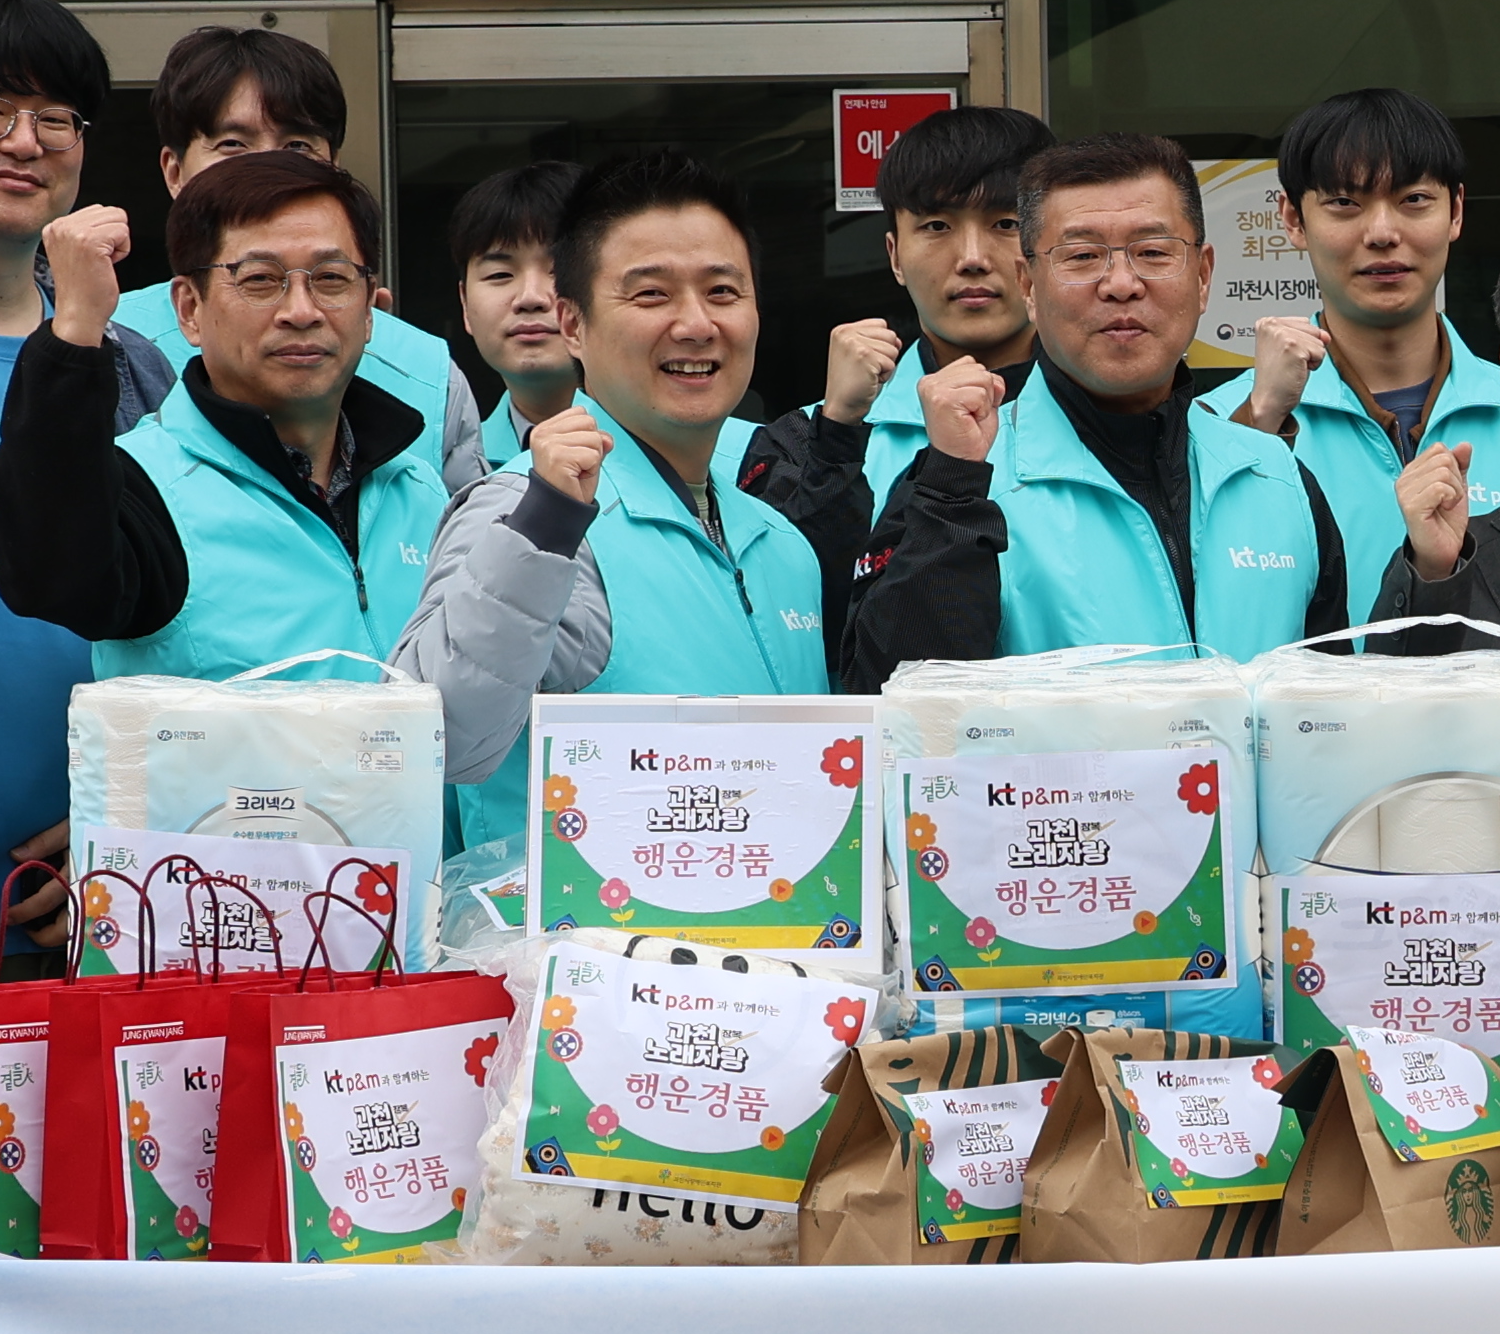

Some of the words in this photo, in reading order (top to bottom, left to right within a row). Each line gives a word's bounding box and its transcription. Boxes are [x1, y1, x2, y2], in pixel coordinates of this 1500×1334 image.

[845, 99, 868, 109] 언제나
[870, 99, 887, 108] 안심
[399, 542, 421, 565] kt
[853, 551, 871, 581] kt
[1229, 546, 1257, 569] kt
[1260, 551, 1296, 571] p&m
[780, 608, 804, 632] kt
[631, 748, 659, 771] kt
[664, 756, 712, 775] p&m
[731, 759, 777, 771] 함께하는
[235, 796, 295, 811] 크리넥스
[668, 785, 719, 808] 과천
[987, 783, 1016, 807] kt
[1022, 787, 1070, 809] p&m
[1088, 790, 1135, 803] 함께하는
[648, 807, 749, 832] 노래자랑
[1027, 819, 1078, 844] 과천
[633, 842, 774, 878] 행운경품
[1008, 840, 1110, 868] 노래자랑
[995, 876, 1137, 916] 행운경품
[201, 900, 252, 926] 과천
[1366, 901, 1394, 925] kt
[1400, 907, 1447, 928] p&m
[1384, 961, 1485, 986] 노래자랑
[632, 983, 661, 1005] kt
[666, 995, 714, 1011] p&m
[733, 1002, 780, 1017] 함께하는
[1024, 1012, 1082, 1027] 크리넥스
[9, 1028, 28, 1040] KWAN
[123, 1028, 142, 1042] JUNG
[143, 1027, 164, 1039] KWAN
[165, 1026, 184, 1038] JANG
[666, 1022, 719, 1046] 과천
[644, 1038, 748, 1073] 노래자랑
[324, 1070, 344, 1094] kt
[626, 1072, 769, 1122] 행운경품
[1407, 1085, 1469, 1114] 행운경품
[1178, 1131, 1251, 1157] 행운경품
[344, 1156, 449, 1203] 행운경품
